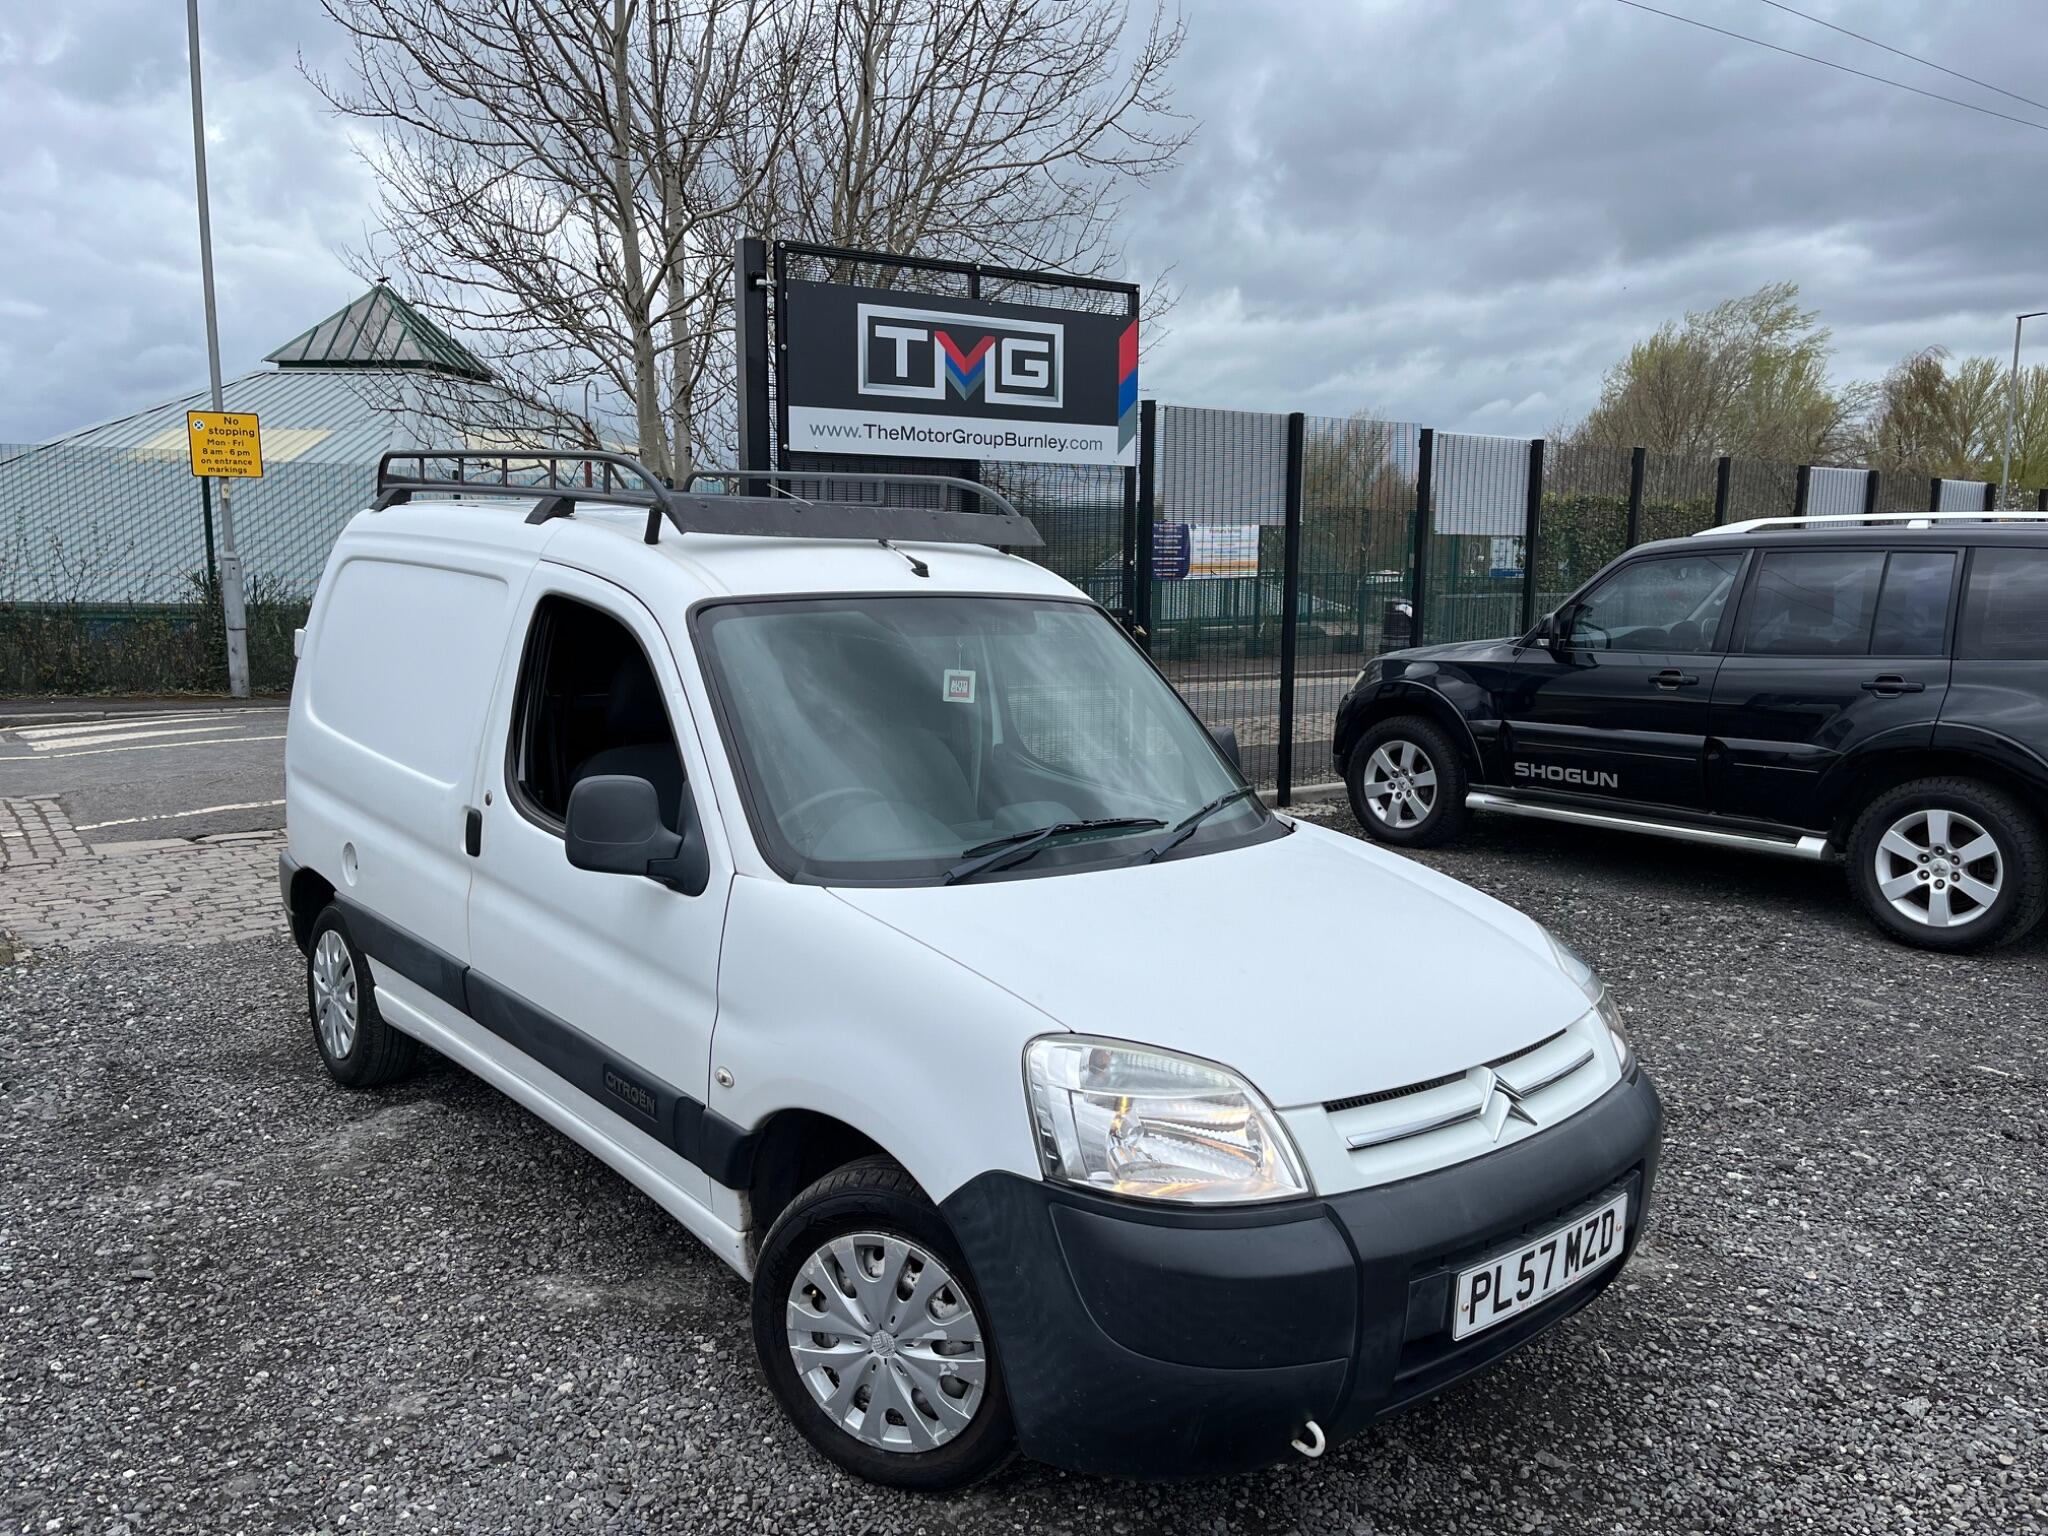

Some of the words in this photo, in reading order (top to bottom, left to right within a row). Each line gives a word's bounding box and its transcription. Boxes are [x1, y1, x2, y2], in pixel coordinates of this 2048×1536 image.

[875, 325, 1049, 400] TMG
[208, 427, 255, 437] stopping
[224, 416, 239, 425] No
[810, 423, 1102, 451] www.TheMotorGroupBurnley.com
[1514, 762, 1618, 788] SHOGUN
[1469, 1239, 1557, 1325] PL57
[1564, 1208, 1615, 1279] MZD
